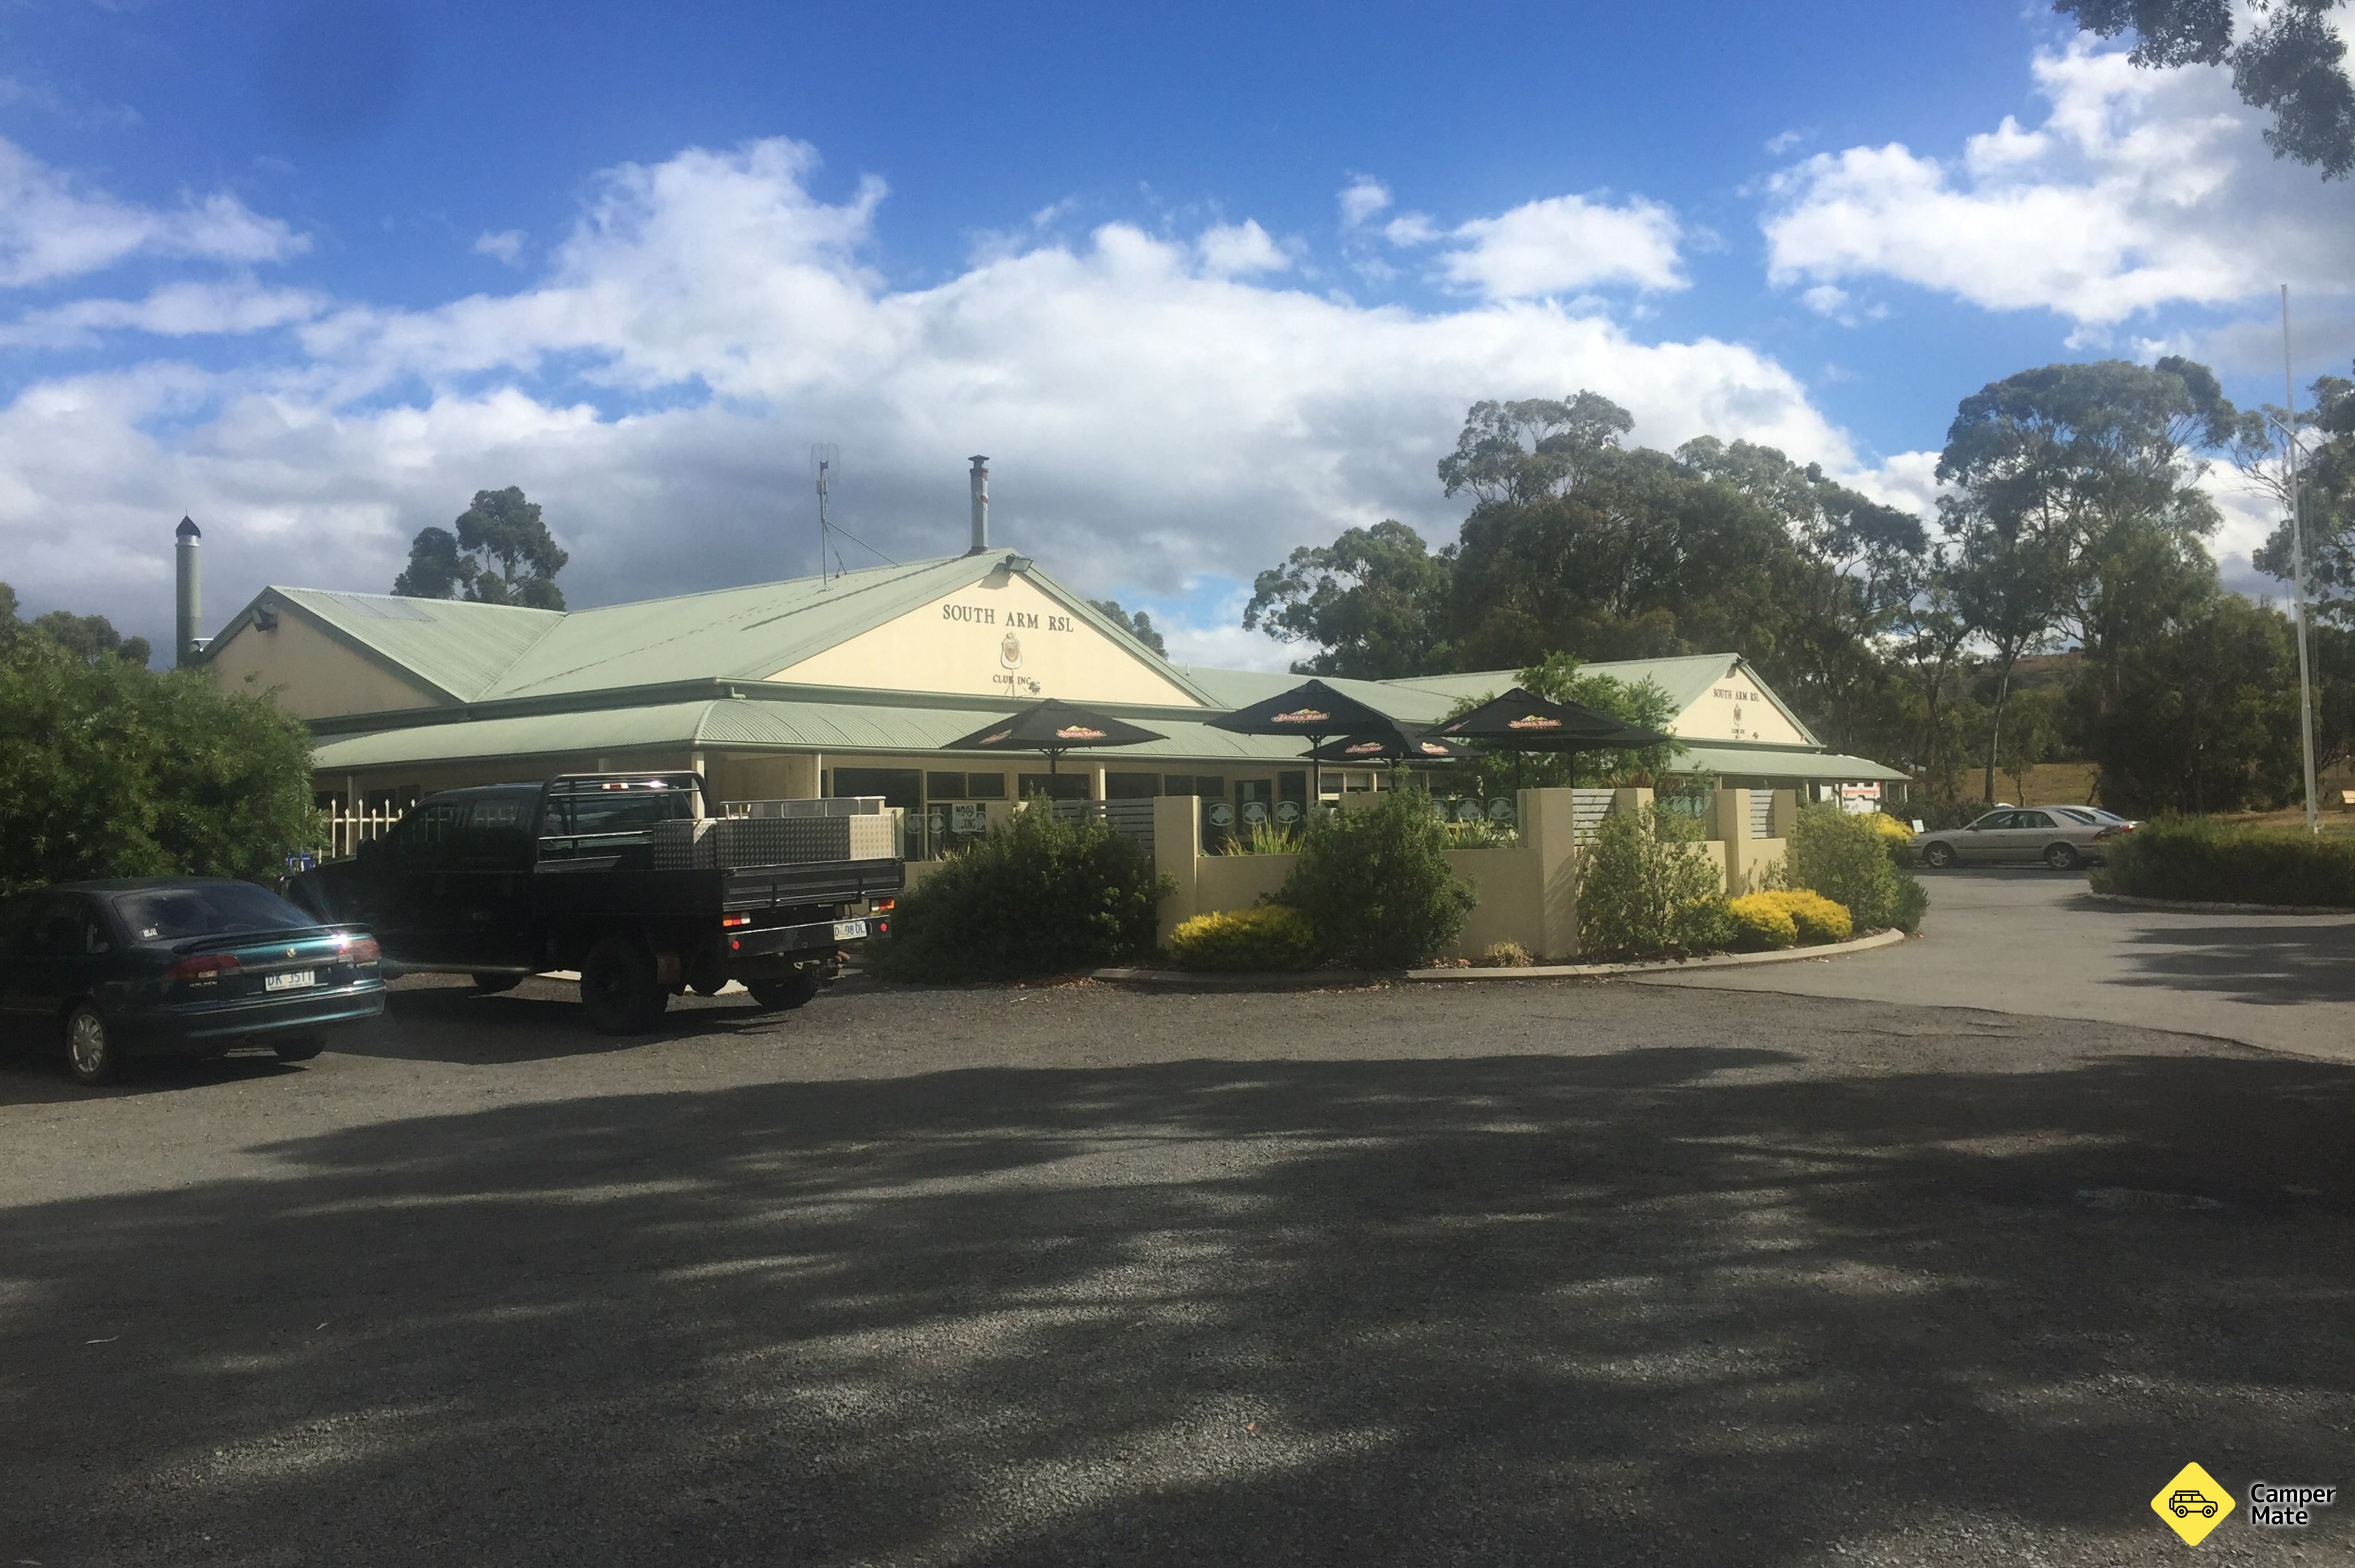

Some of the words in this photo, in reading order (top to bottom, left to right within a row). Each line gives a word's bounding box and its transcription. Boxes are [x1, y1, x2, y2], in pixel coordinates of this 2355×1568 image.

[943, 604, 995, 624] SOUTH
[1005, 611, 1039, 629] ARM
[1048, 616, 1074, 632] RSL
[993, 675, 1014, 684] CLUB
[1713, 688, 1732, 699] SOUTH
[1735, 690, 1747, 700] ARM
[1750, 692, 1759, 702] RSL
[268, 975, 282, 985] DK
